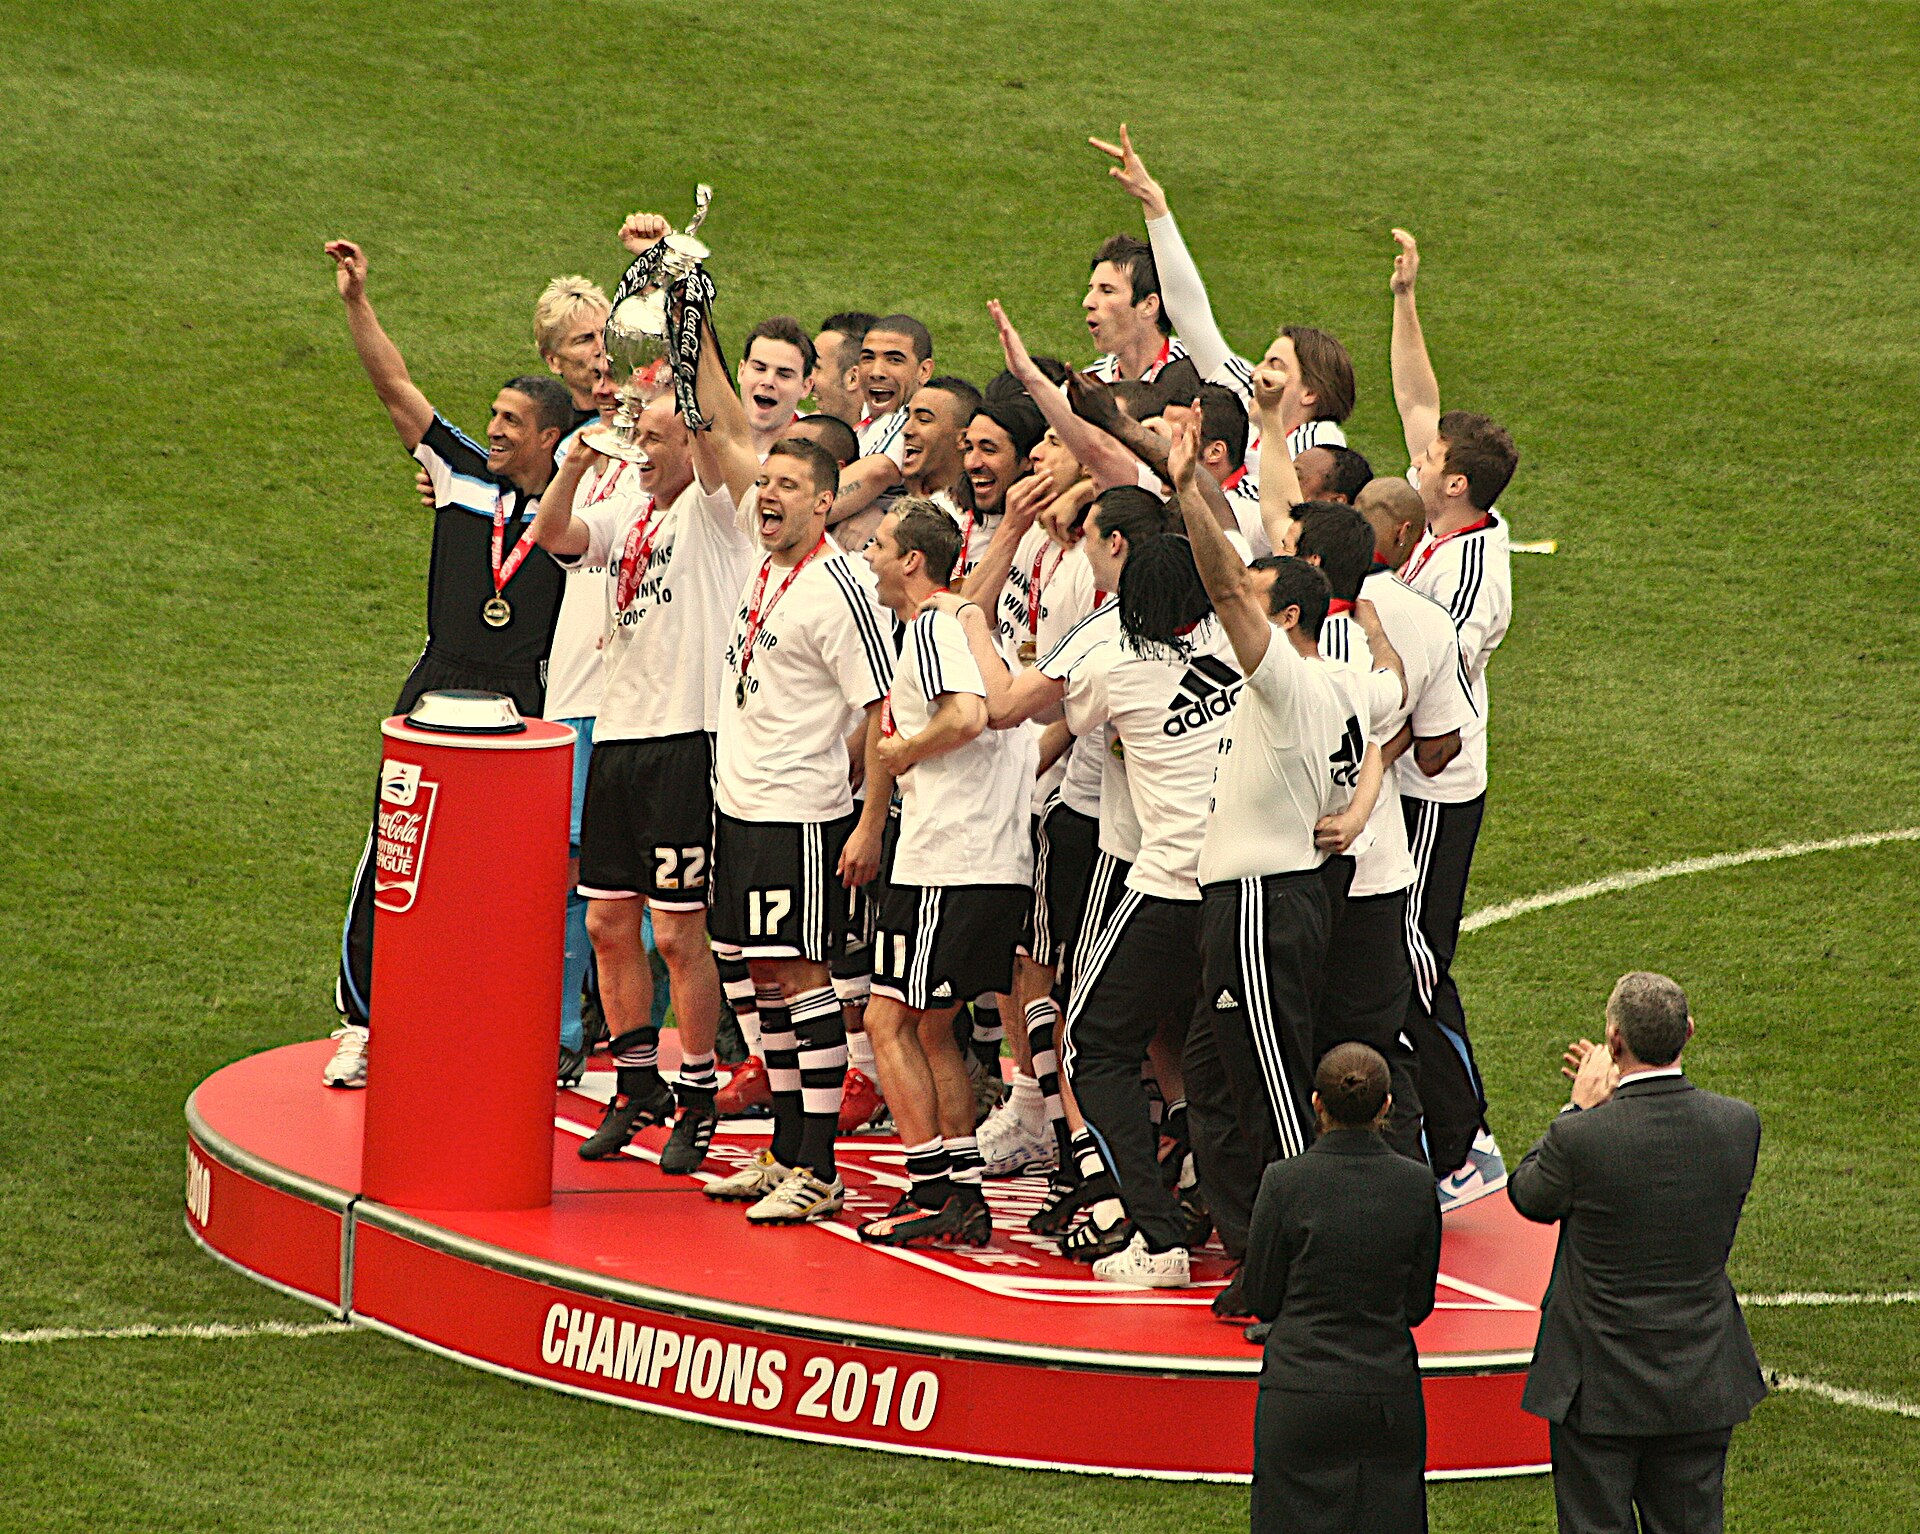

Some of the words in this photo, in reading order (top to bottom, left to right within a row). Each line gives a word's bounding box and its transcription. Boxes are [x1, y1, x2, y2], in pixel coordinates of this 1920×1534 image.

[681, 306, 701, 361] Coca-Cola
[655, 846, 706, 890] 22
[749, 889, 791, 936] 17
[874, 930, 907, 978] 11
[541, 1302, 788, 1411] CHAMPIONS
[795, 1356, 940, 1433] 2010
